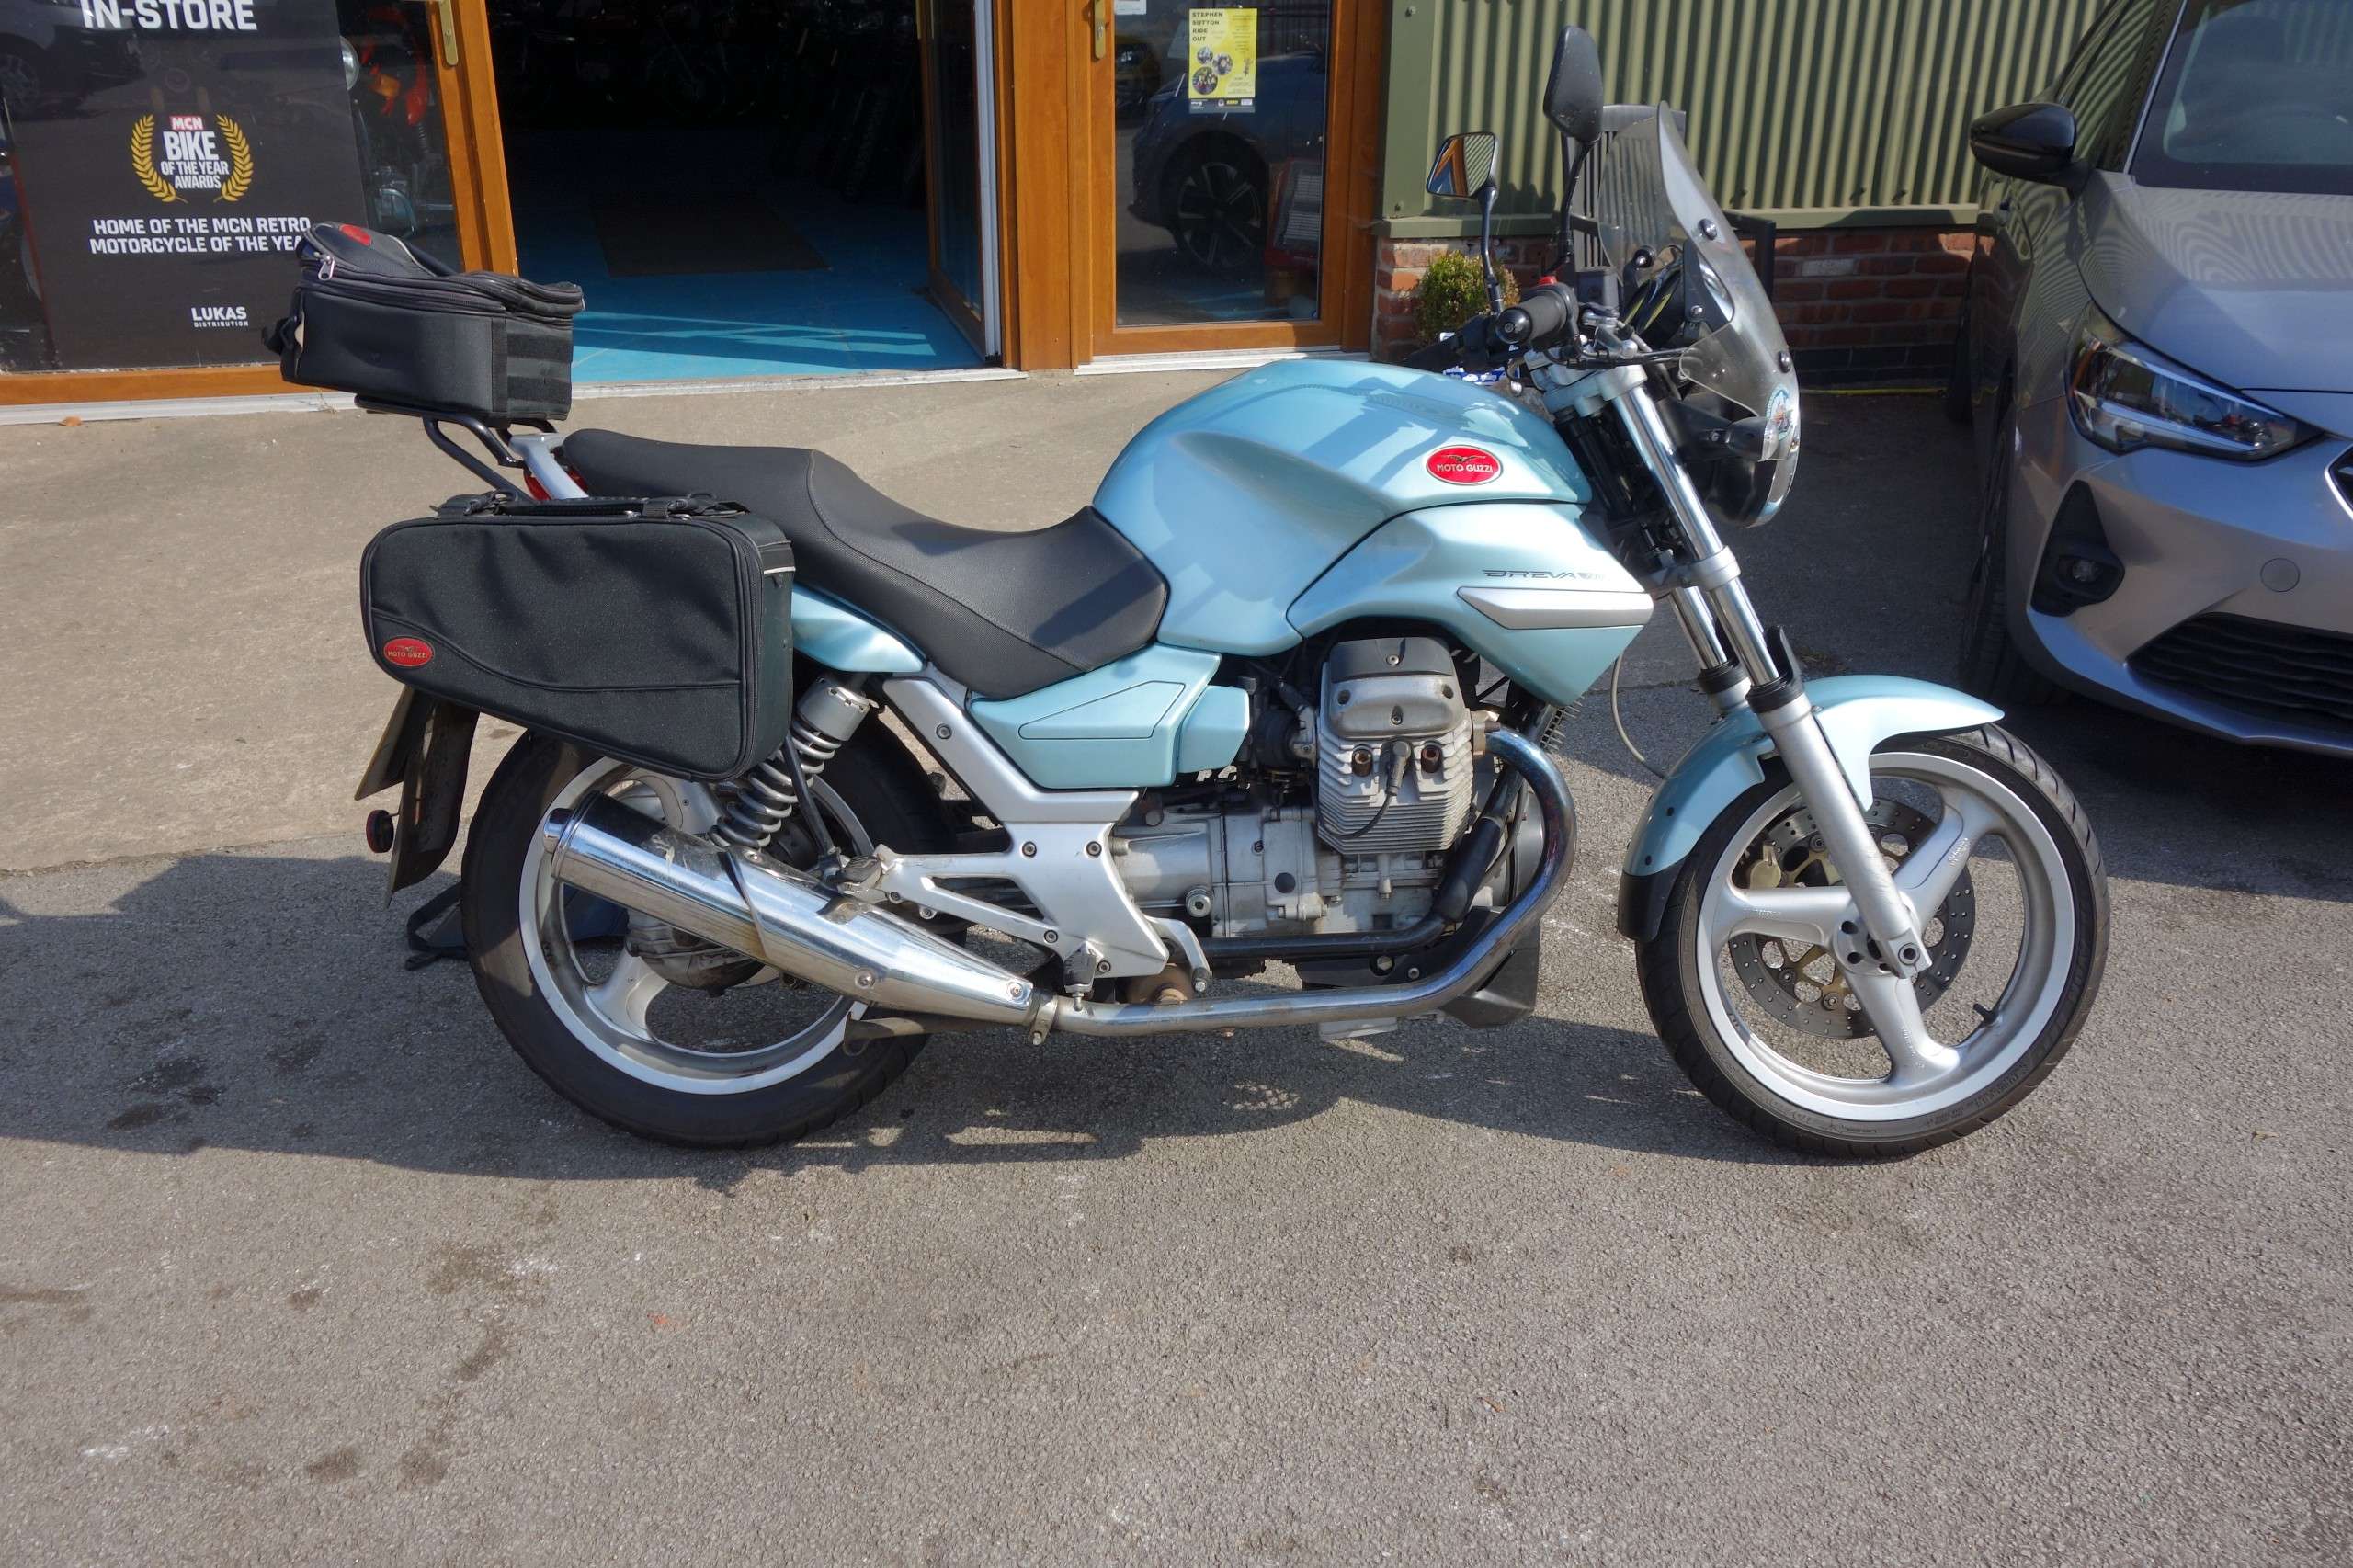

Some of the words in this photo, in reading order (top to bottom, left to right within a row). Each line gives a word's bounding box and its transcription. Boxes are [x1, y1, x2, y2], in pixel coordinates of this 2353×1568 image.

[80, 0, 257, 30] IN-STORE
[172, 117, 203, 130] MCN
[163, 131, 220, 160] BIKE
[160, 161, 176, 176] OF
[176, 161, 199, 175] THE
[198, 160, 230, 175] YEAR
[175, 175, 222, 189] AWARDS
[93, 219, 146, 235] HOME
[149, 219, 172, 234] OF
[175, 218, 210, 233] THE
[212, 217, 253, 233] MCN
[256, 217, 311, 233] RETRO
[89, 237, 208, 254] MOTORCYCLE
[210, 236, 233, 252] OF
[235, 235, 269, 252] THE
[271, 235, 302, 251] YEA
[191, 306, 247, 321] LUKAS
[1466, 464, 1494, 473] GUZZI
[1482, 569, 1577, 579] BREVA
